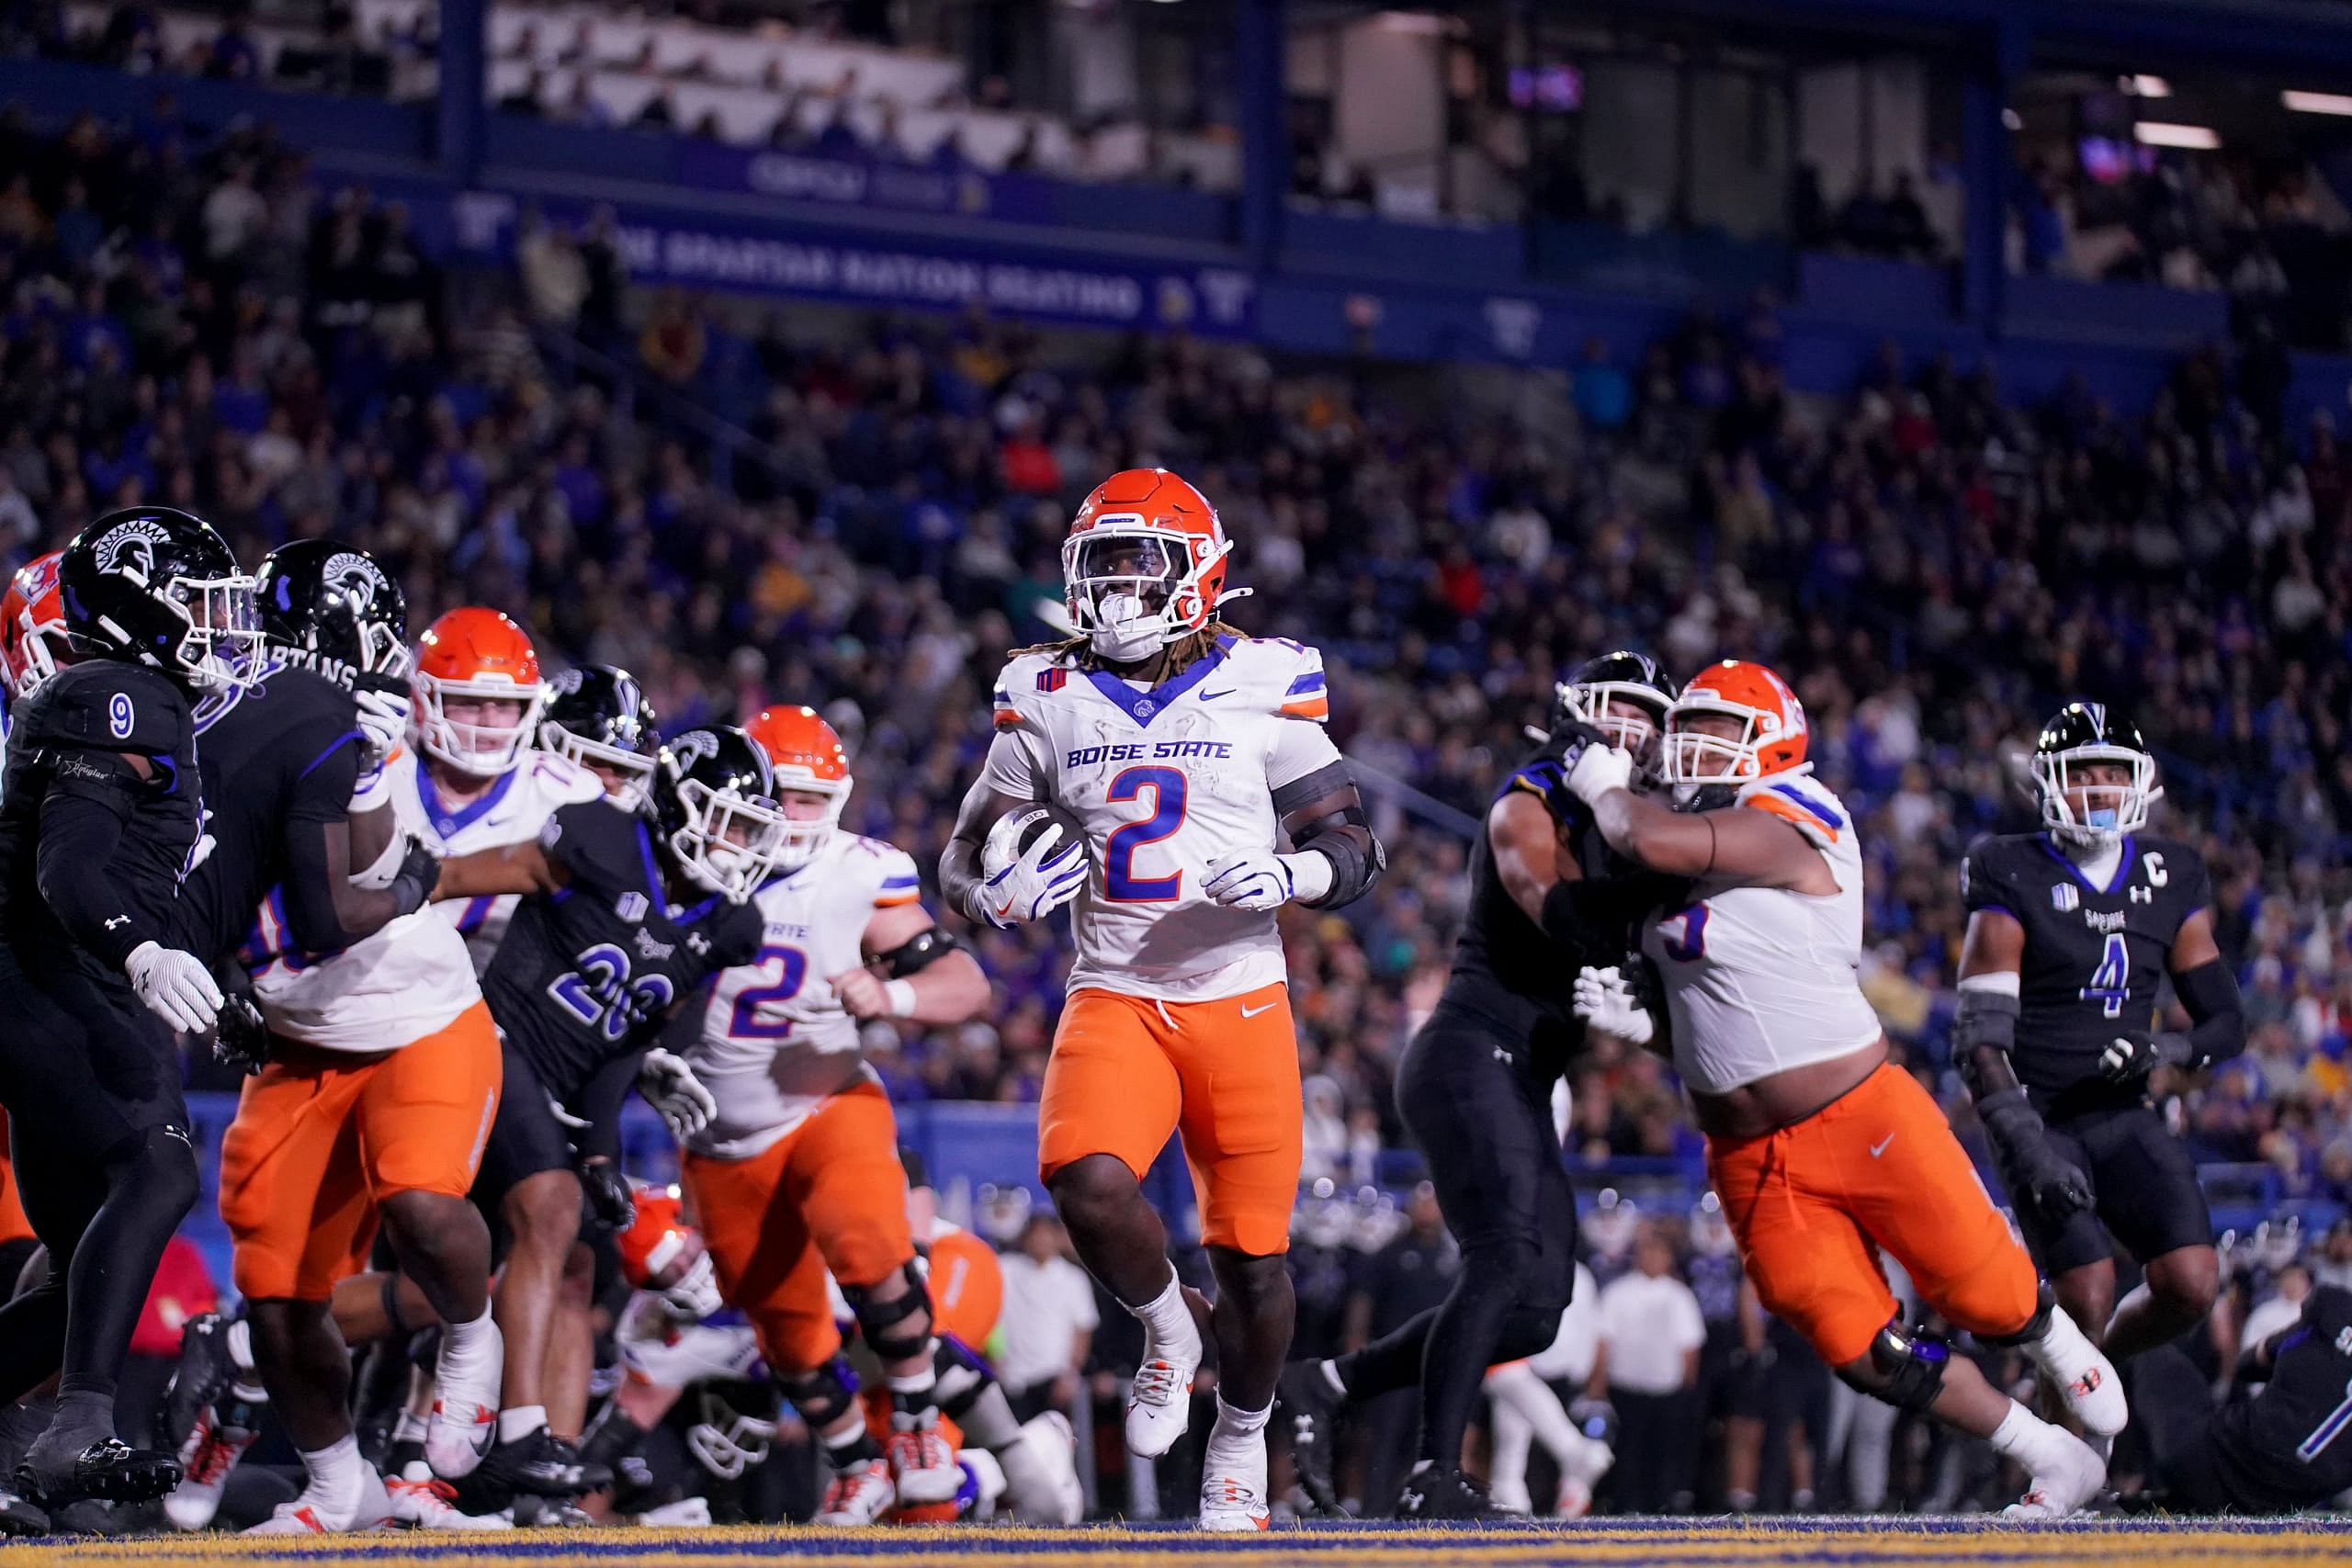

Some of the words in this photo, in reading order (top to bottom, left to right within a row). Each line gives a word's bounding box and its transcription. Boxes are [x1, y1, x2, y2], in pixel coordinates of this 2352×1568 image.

[109, 693, 134, 739] 9
[1067, 744, 1147, 769] BOISE
[1153, 740, 1233, 759] STATE
[1104, 765, 1188, 902] 2
[2143, 852, 2167, 887] C
[2079, 932, 2130, 1019] 4
